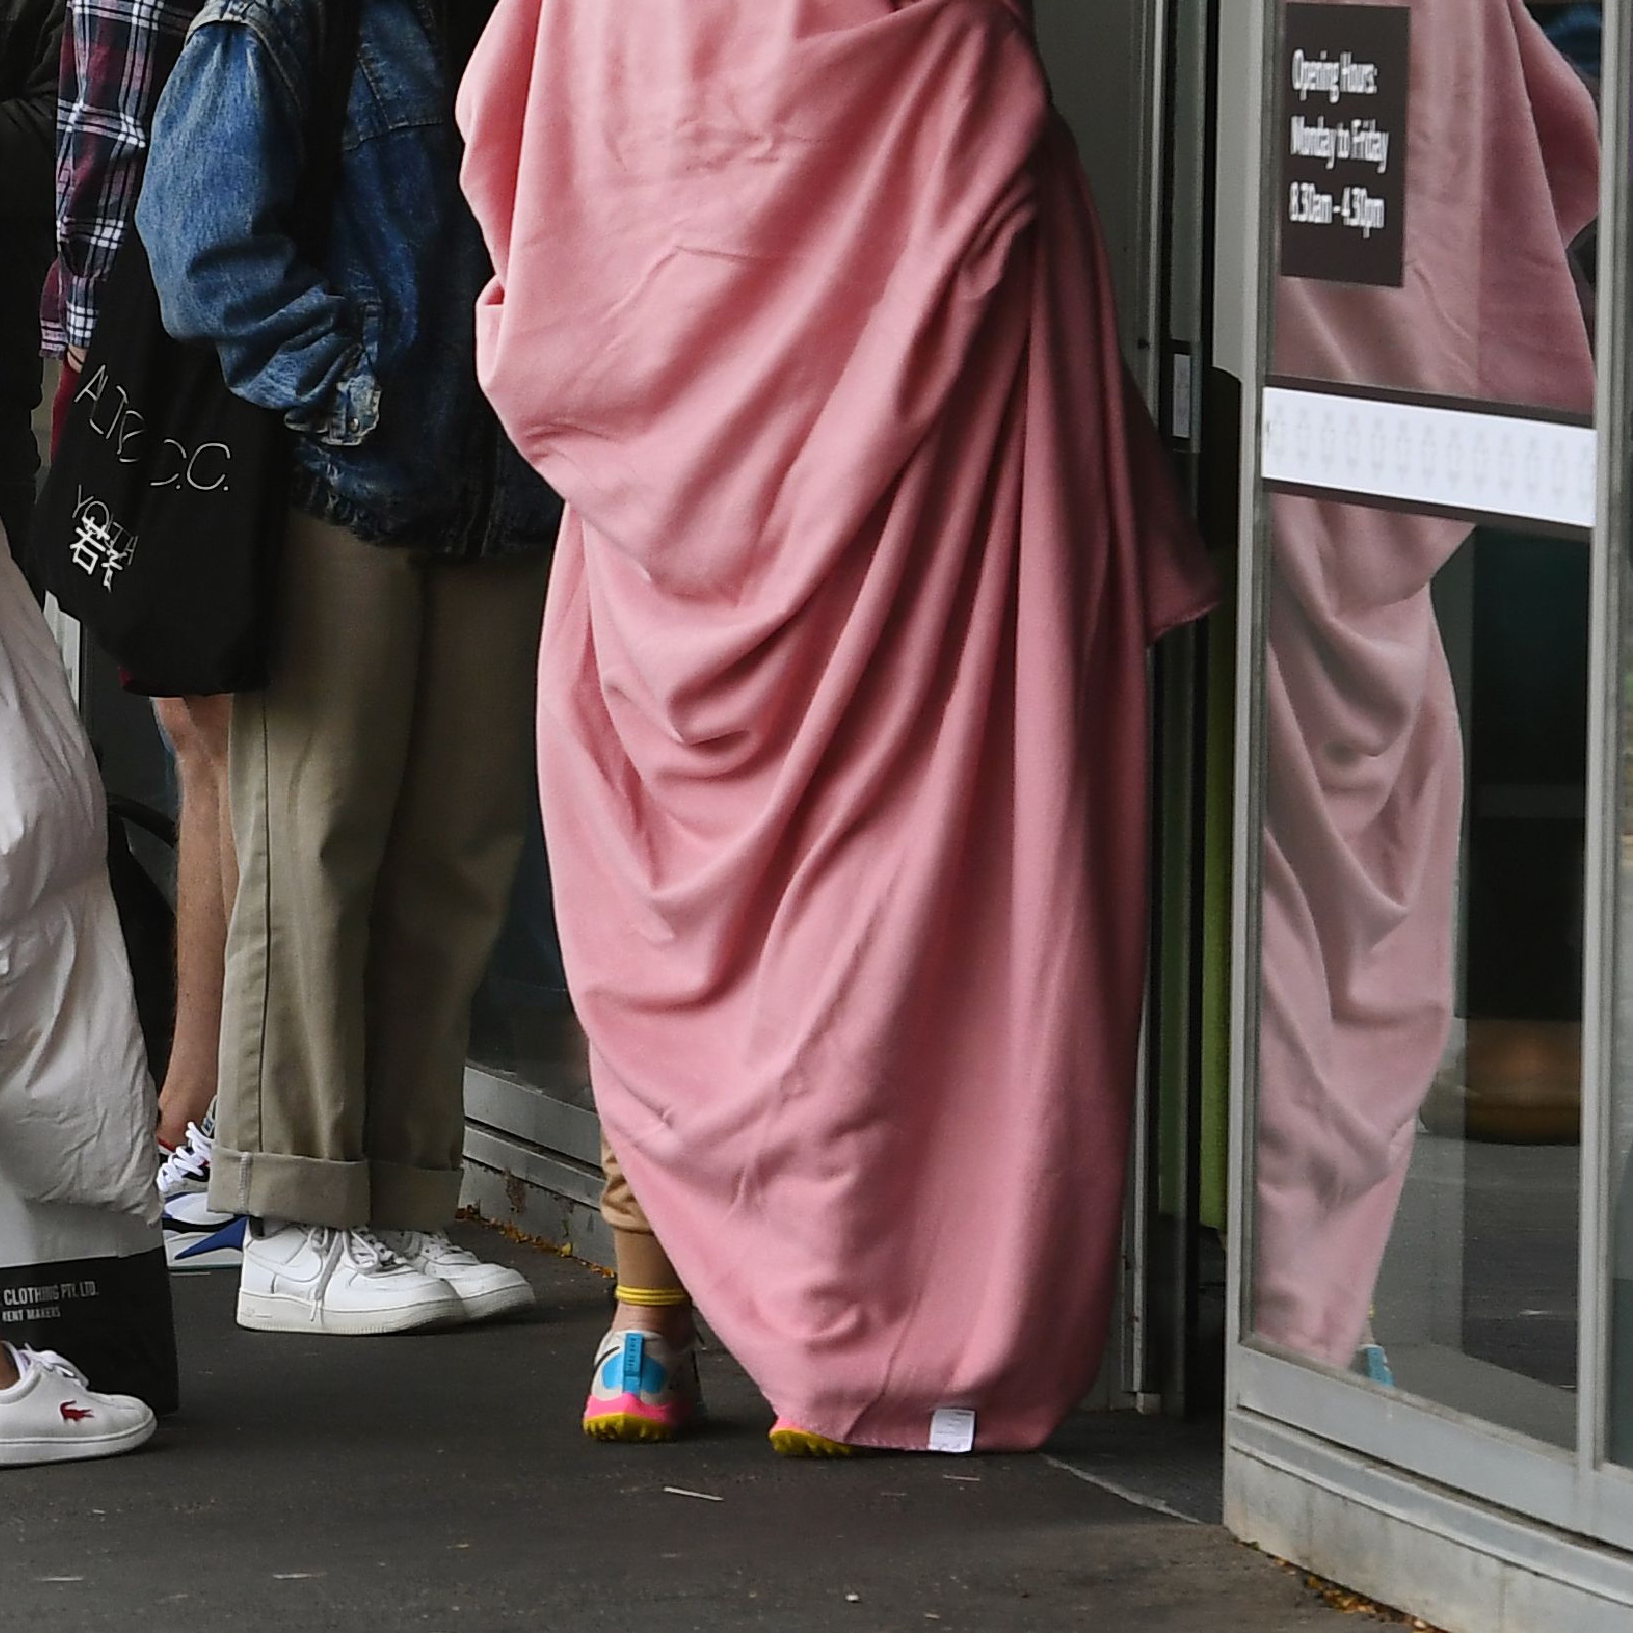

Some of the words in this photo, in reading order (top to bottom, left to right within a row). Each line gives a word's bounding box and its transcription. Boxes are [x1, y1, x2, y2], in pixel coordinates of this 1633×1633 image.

[1291, 48, 1339, 103] Opening
[1290, 115, 1337, 170] Monday
[1337, 121, 1350, 159] to
[1350, 118, 1389, 174] Friday
[1289, 180, 1333, 224] 8.30am
[1341, 186, 1385, 239] 4.30pm
